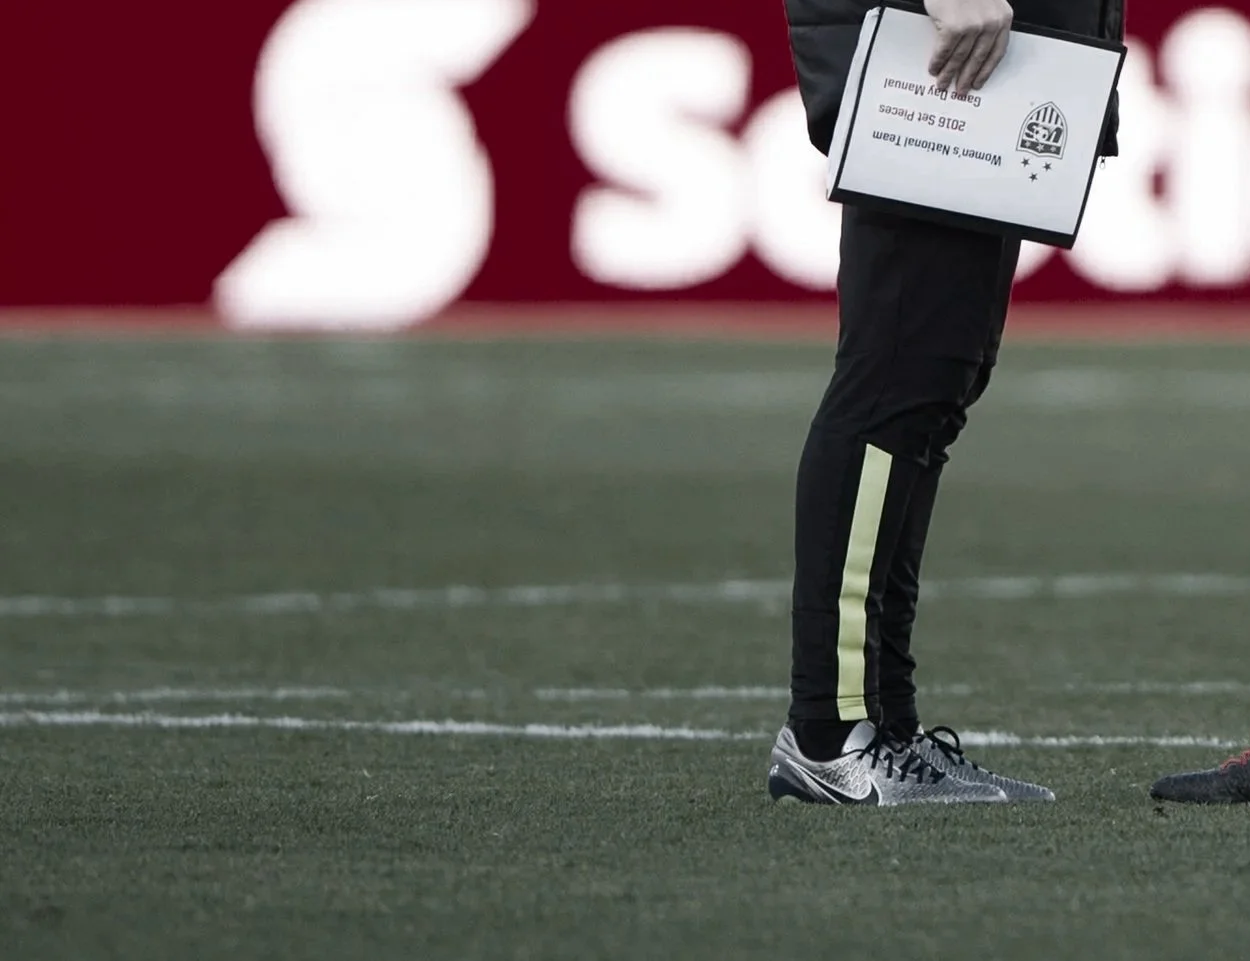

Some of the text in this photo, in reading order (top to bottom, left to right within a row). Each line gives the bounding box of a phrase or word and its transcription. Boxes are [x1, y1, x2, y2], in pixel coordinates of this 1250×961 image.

[883, 78, 982, 108] Game Day Manual
[878, 104, 966, 131] 2016 Set Pieces
[872, 130, 1002, 166] Women's National Team
